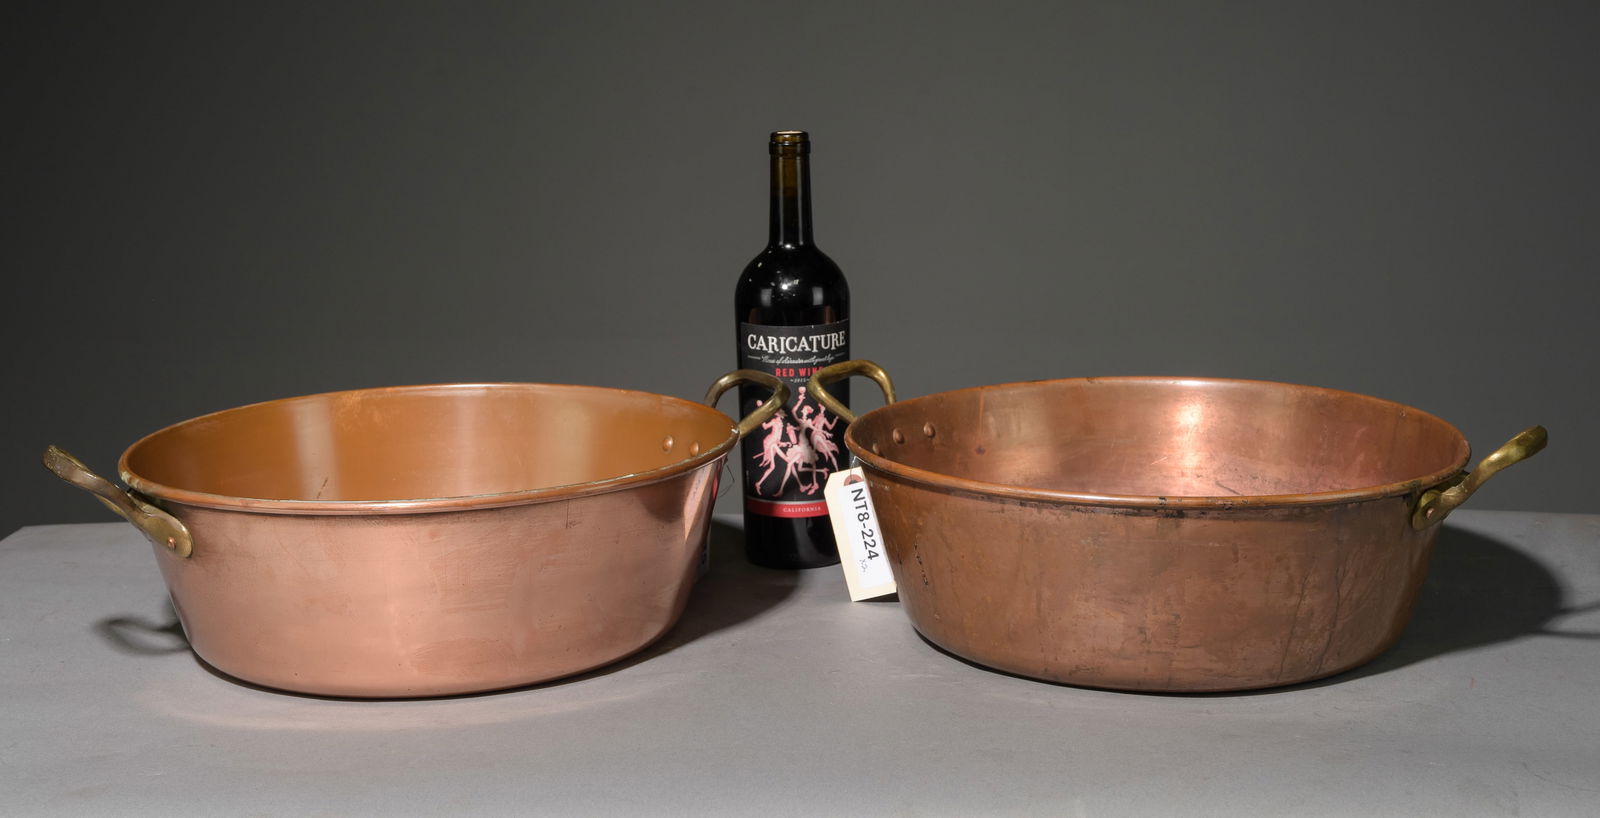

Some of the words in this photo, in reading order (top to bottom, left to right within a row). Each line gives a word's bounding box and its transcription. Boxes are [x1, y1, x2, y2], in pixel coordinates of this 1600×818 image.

[747, 331, 846, 354] CARICATURE
[775, 367, 795, 377] RED
[799, 366, 824, 377] WIN
[851, 488, 880, 561] NT8-224
